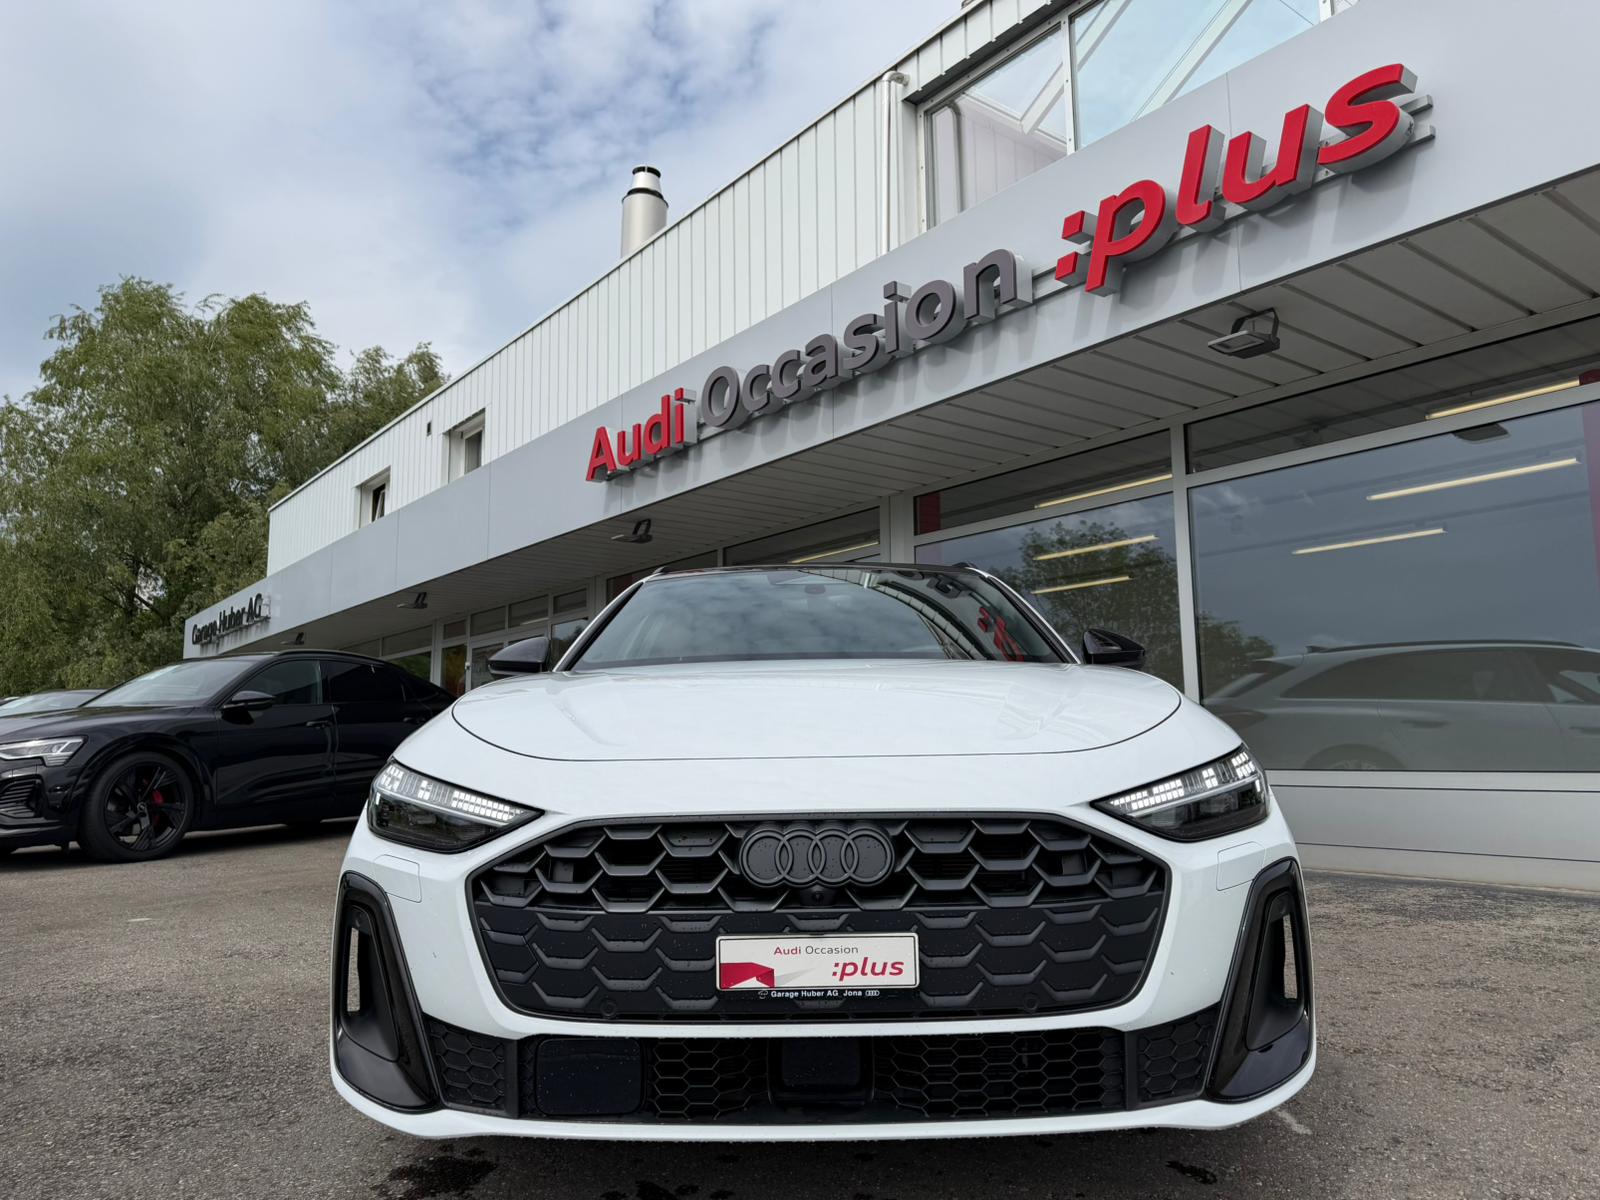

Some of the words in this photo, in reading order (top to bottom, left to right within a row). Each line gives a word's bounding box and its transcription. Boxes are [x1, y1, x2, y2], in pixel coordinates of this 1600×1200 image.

[585, 387, 687, 481] Audi
[700, 248, 1020, 428] Occasion
[1055, 63, 1406, 294] :plus
[192, 620, 217, 645] Garage
[219, 606, 246, 633] Huber
[247, 593, 263, 622] AG
[774, 946, 801, 956] Audi
[805, 945, 859, 955] Occasion
[832, 957, 904, 982] :plus
[770, 990, 799, 999] Garage
[801, 989, 825, 998] Huber
[826, 989, 839, 997] AG
[843, 989, 862, 997] Jona
